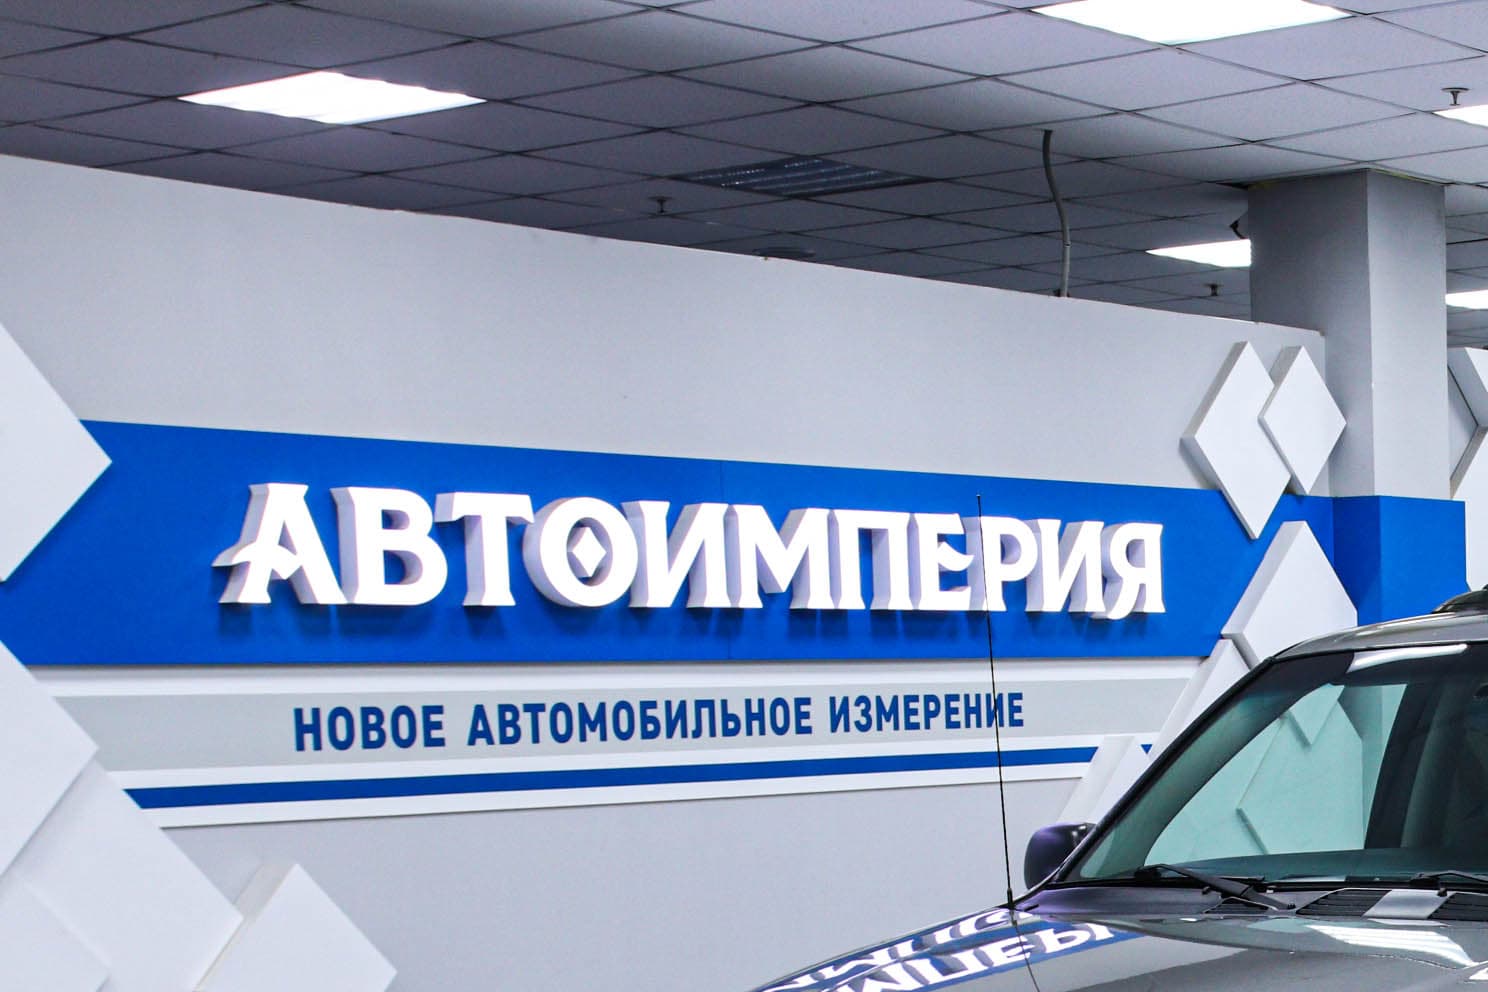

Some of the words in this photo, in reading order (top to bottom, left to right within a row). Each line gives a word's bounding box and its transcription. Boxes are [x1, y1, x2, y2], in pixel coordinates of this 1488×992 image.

[212, 483, 1166, 619] АВТОИМПЕРИЯ
[294, 705, 446, 752] НОВОЕ
[467, 696, 813, 746] АВТОМОБИЛЬНОЕ
[829, 692, 1024, 733] ИЗМЕРЕНИЕ
